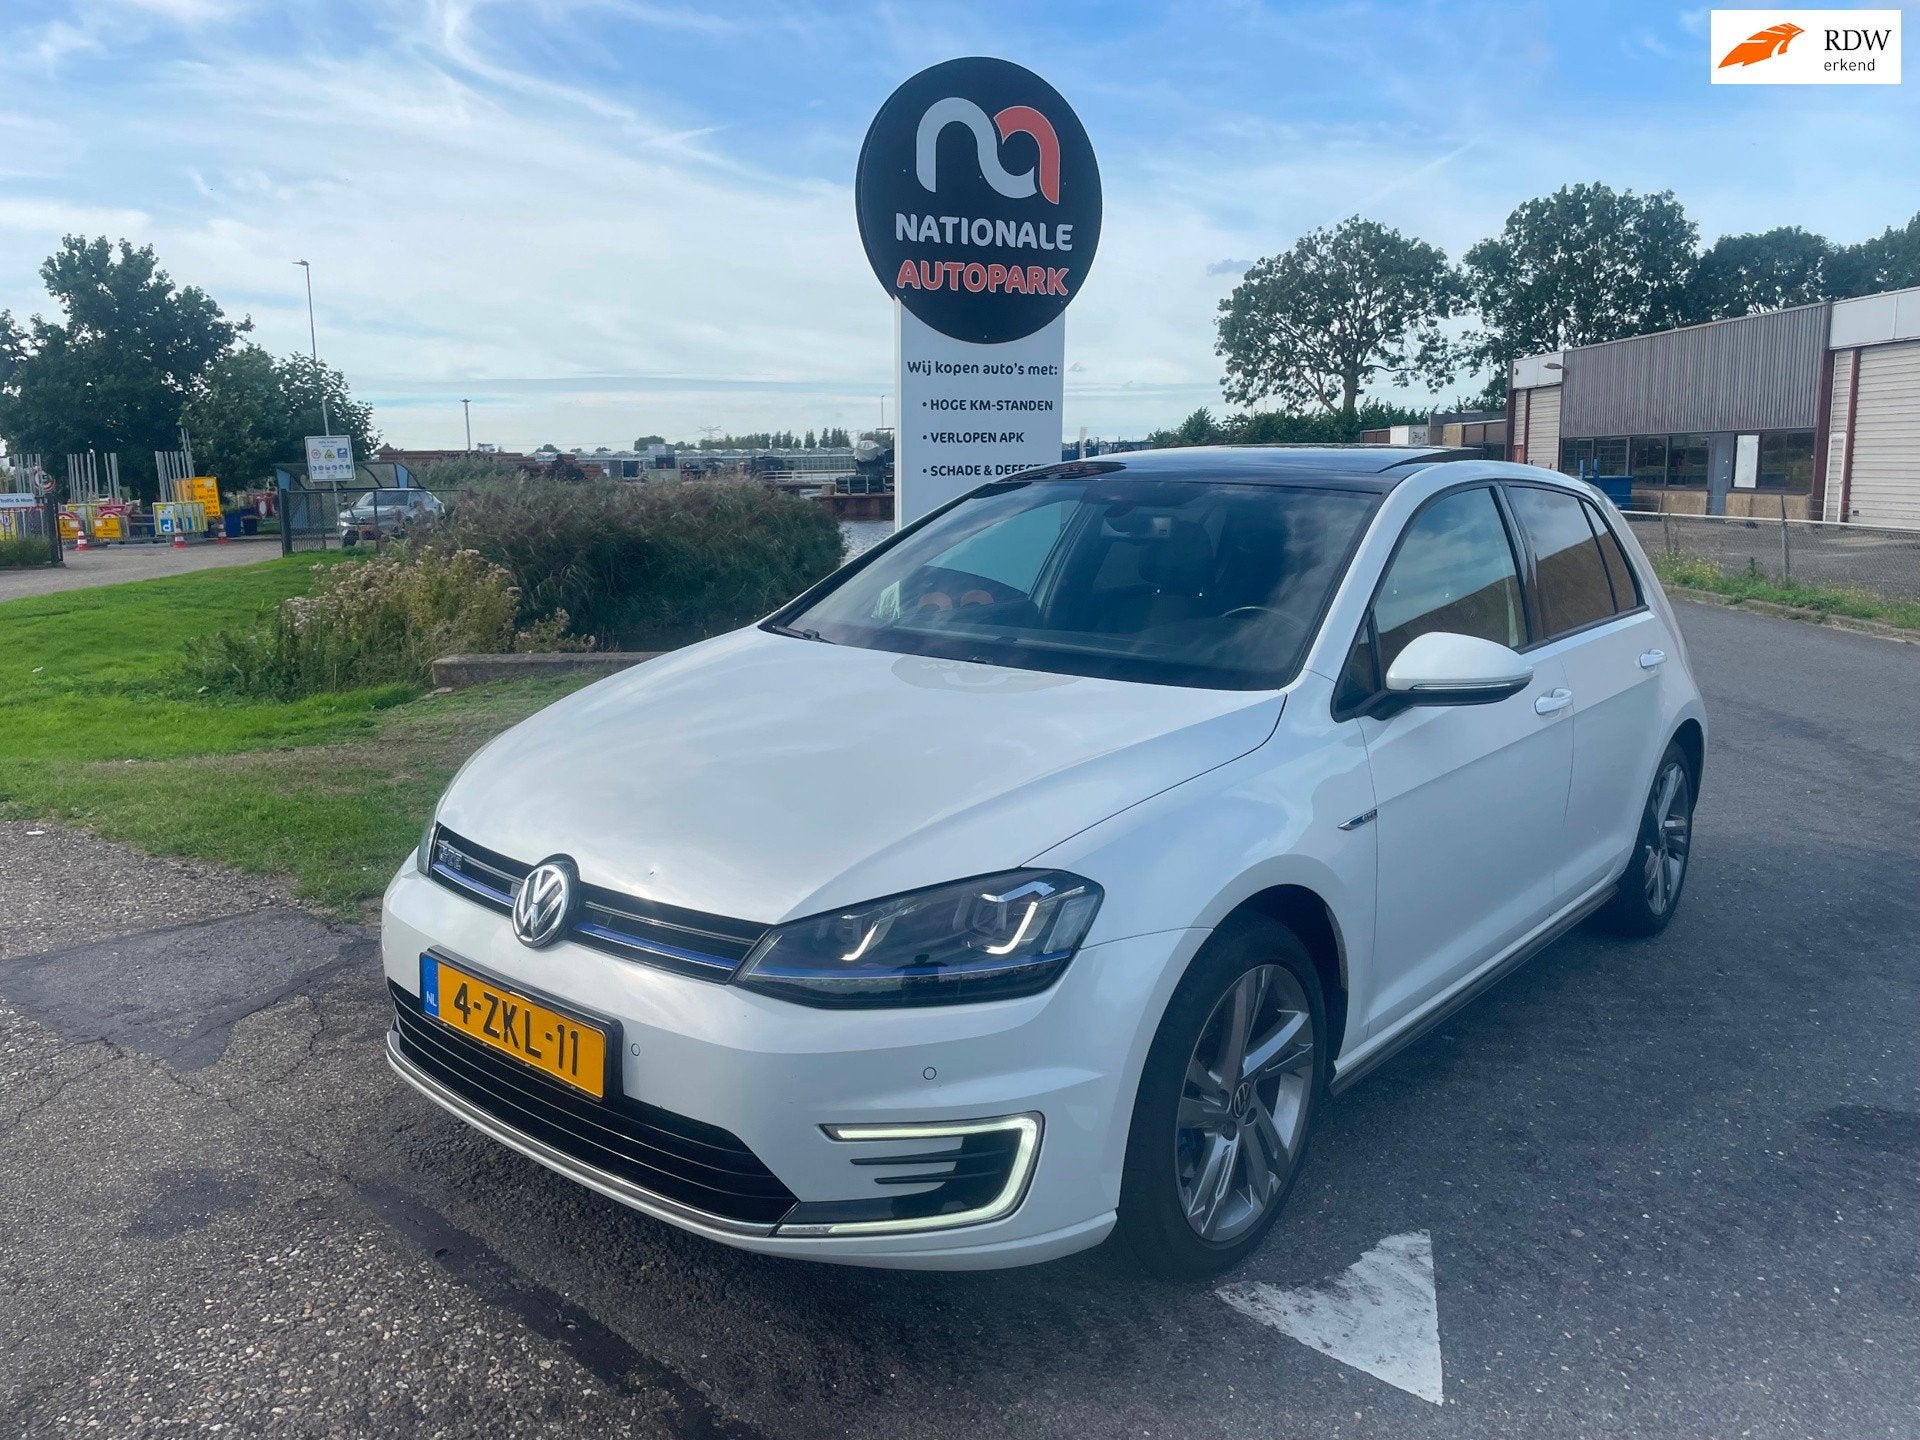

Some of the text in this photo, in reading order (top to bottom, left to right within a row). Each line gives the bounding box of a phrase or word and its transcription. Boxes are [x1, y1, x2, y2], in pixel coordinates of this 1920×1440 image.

[895, 212, 1073, 251] NATIONALE
[896, 259, 1069, 296] AUTOPARK
[907, 360, 1058, 376] Wij kopen auto's met:
[930, 399, 1053, 411] HOGE KM-STANDEN
[930, 432, 1025, 443] VERLOPEN APK
[930, 465, 981, 476] SCHADE
[984, 464, 993, 476] &
[426, 991, 437, 1007] NL
[453, 981, 579, 1077] 4-ZKL-11
